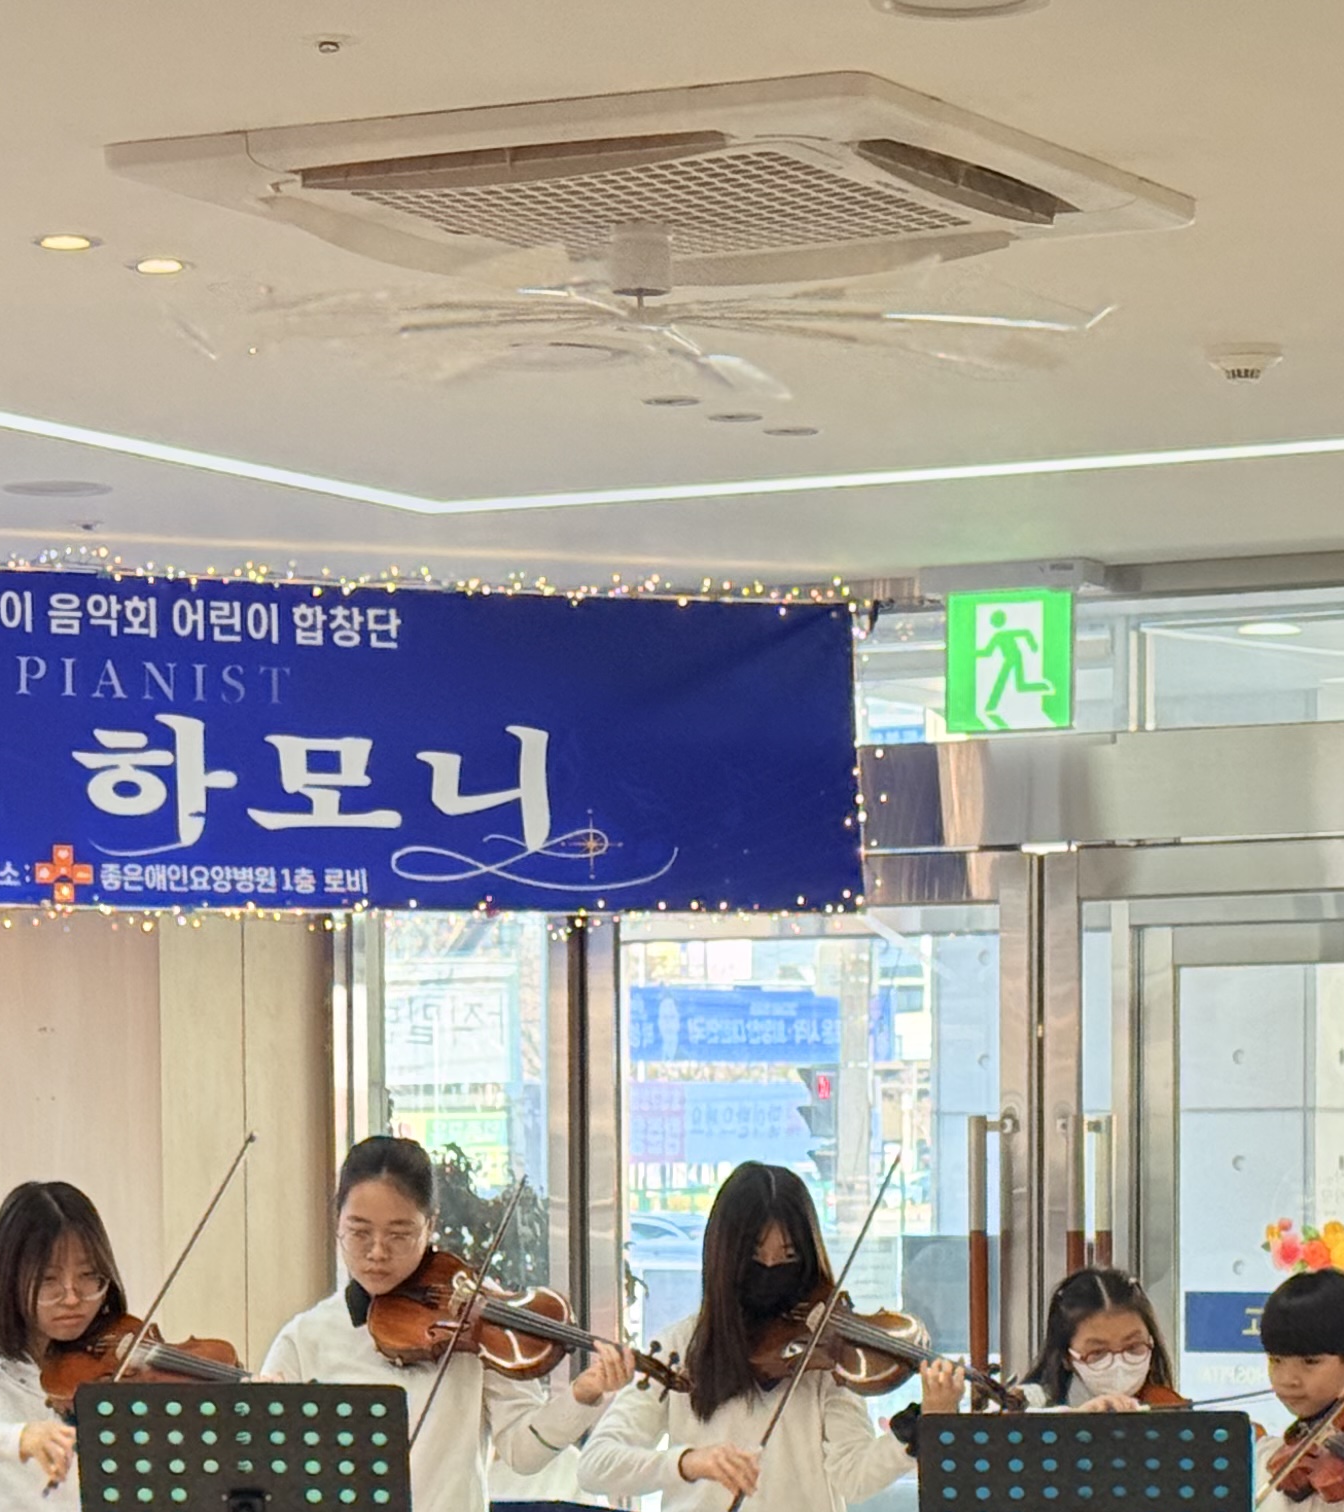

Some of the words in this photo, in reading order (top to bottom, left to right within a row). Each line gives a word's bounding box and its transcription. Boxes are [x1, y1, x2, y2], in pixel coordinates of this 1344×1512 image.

[47, 590, 157, 638] 음악회
[171, 598, 280, 645] 어린이
[291, 602, 402, 649] 합창단
[15, 654, 292, 705] PIANIST
[71, 713, 553, 851] 하모니
[100, 862, 278, 893] 좋은애인요양병원
[281, 867, 317, 894] 1층
[323, 867, 369, 895] 로비
